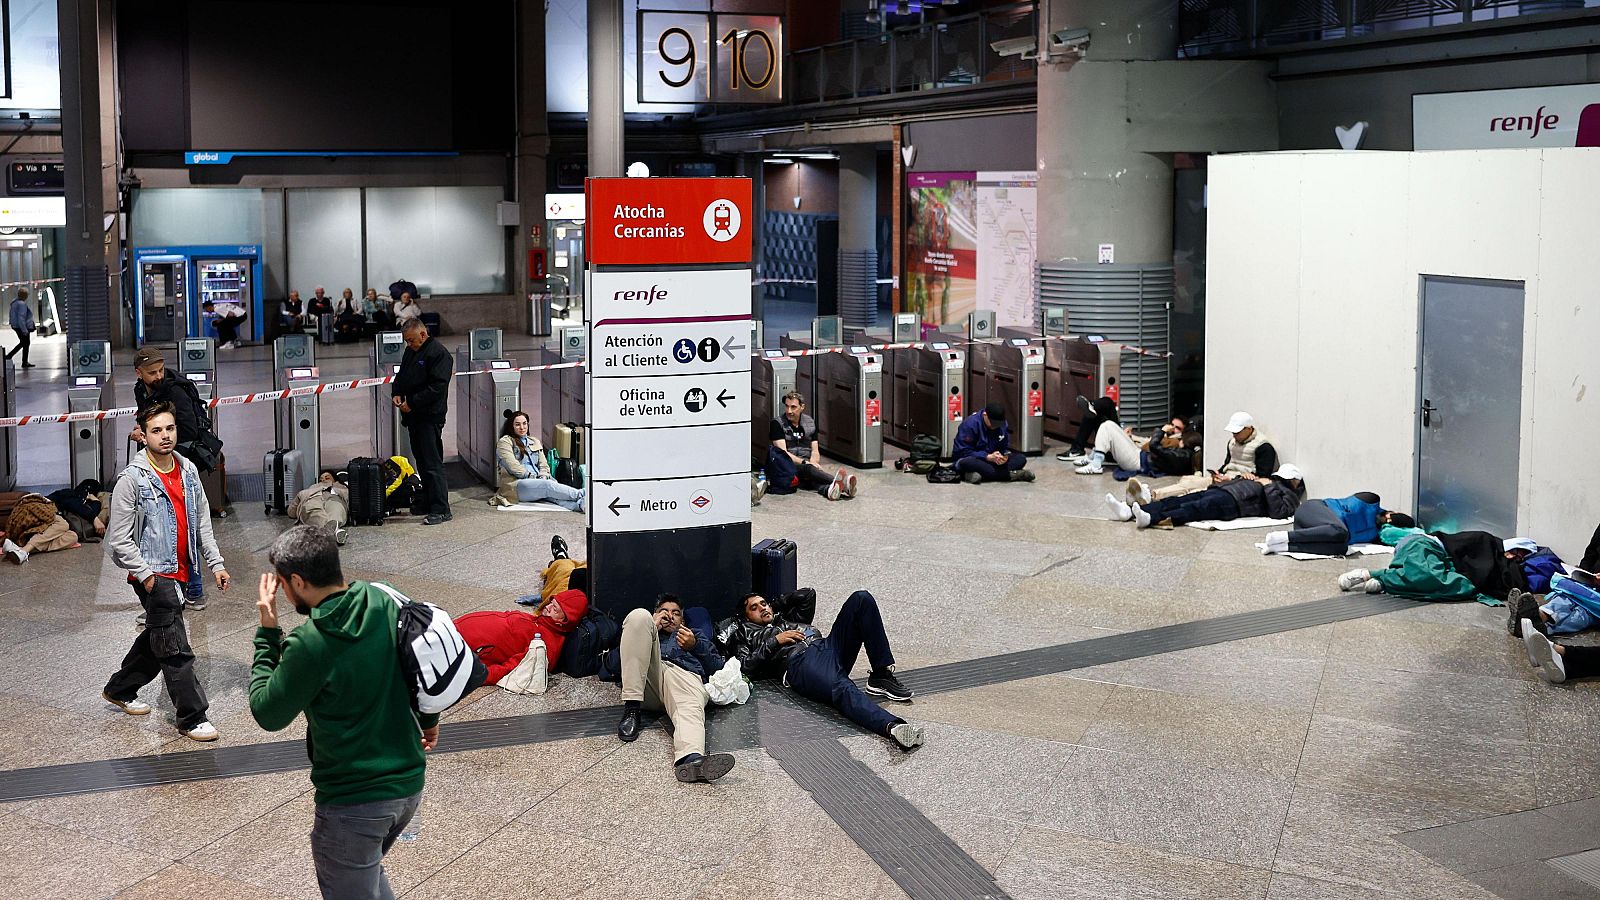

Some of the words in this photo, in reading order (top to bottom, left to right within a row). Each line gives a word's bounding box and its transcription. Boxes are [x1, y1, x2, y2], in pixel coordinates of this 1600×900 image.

[658, 27, 696, 88] 9
[721, 29, 776, 89] 10
[1490, 105, 1559, 139] renfe
[193, 152, 218, 164] global
[613, 203, 665, 219] Atocha
[614, 222, 685, 238] Cercanías
[613, 284, 668, 306] renfe
[604, 333, 663, 348] Atención
[604, 354, 618, 367] al
[622, 353, 668, 367] Cliente
[619, 388, 665, 401] Oficina
[619, 404, 635, 416] de
[637, 404, 673, 416] Venta
[640, 499, 678, 512] Metro
